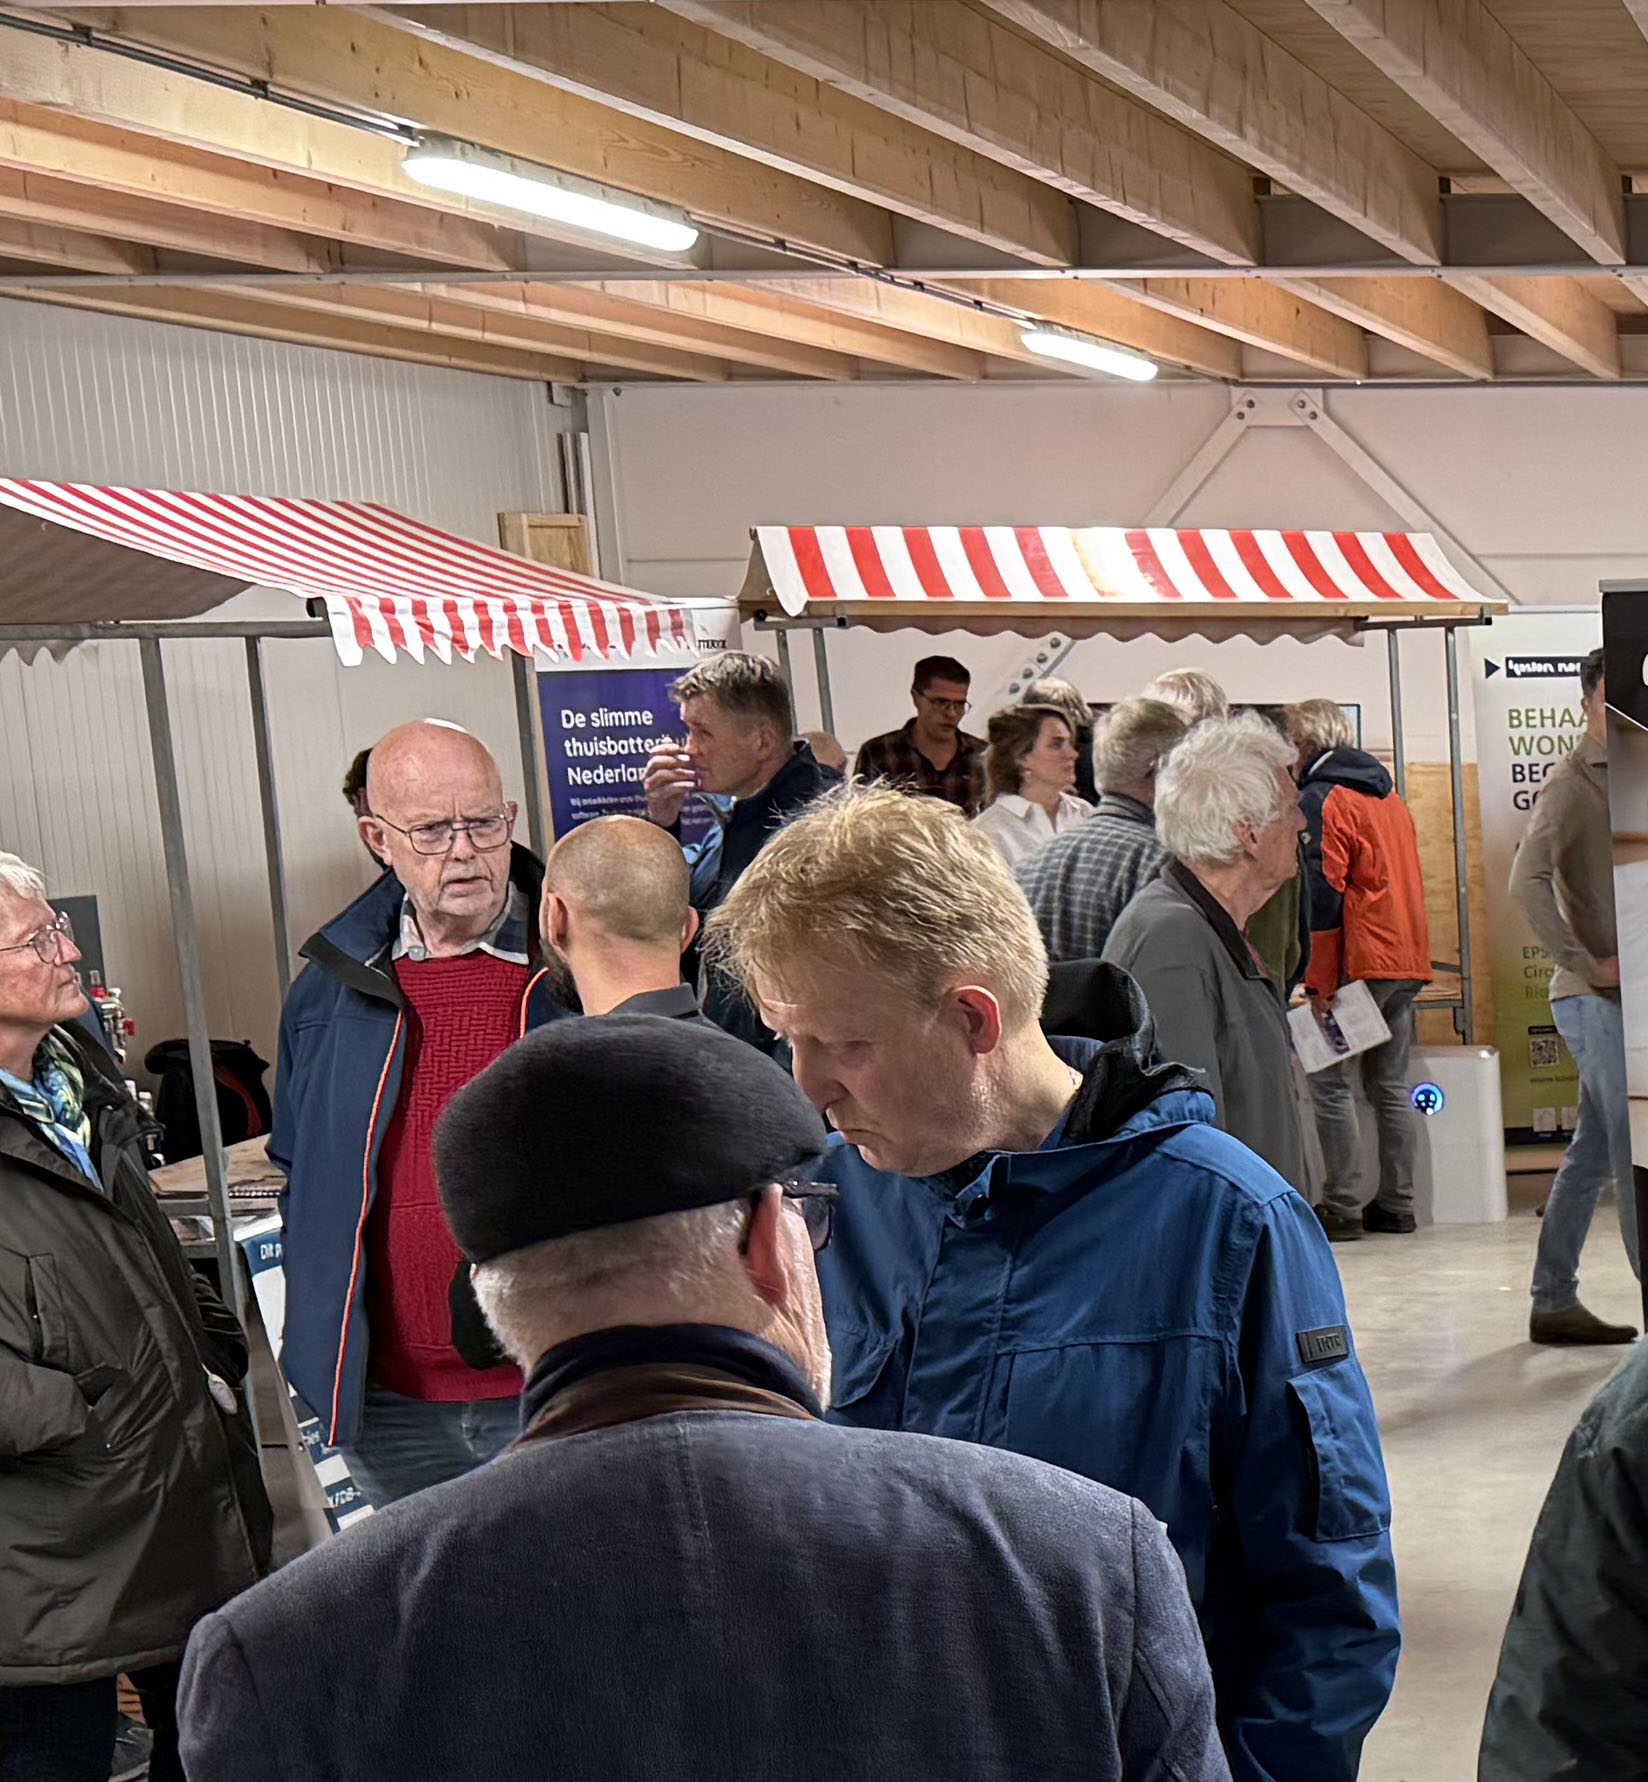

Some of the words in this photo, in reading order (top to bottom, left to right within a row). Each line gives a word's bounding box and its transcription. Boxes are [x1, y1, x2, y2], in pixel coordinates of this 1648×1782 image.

[561, 709, 586, 729] De
[591, 707, 653, 728] slimme
[1508, 735, 1580, 756] WON
